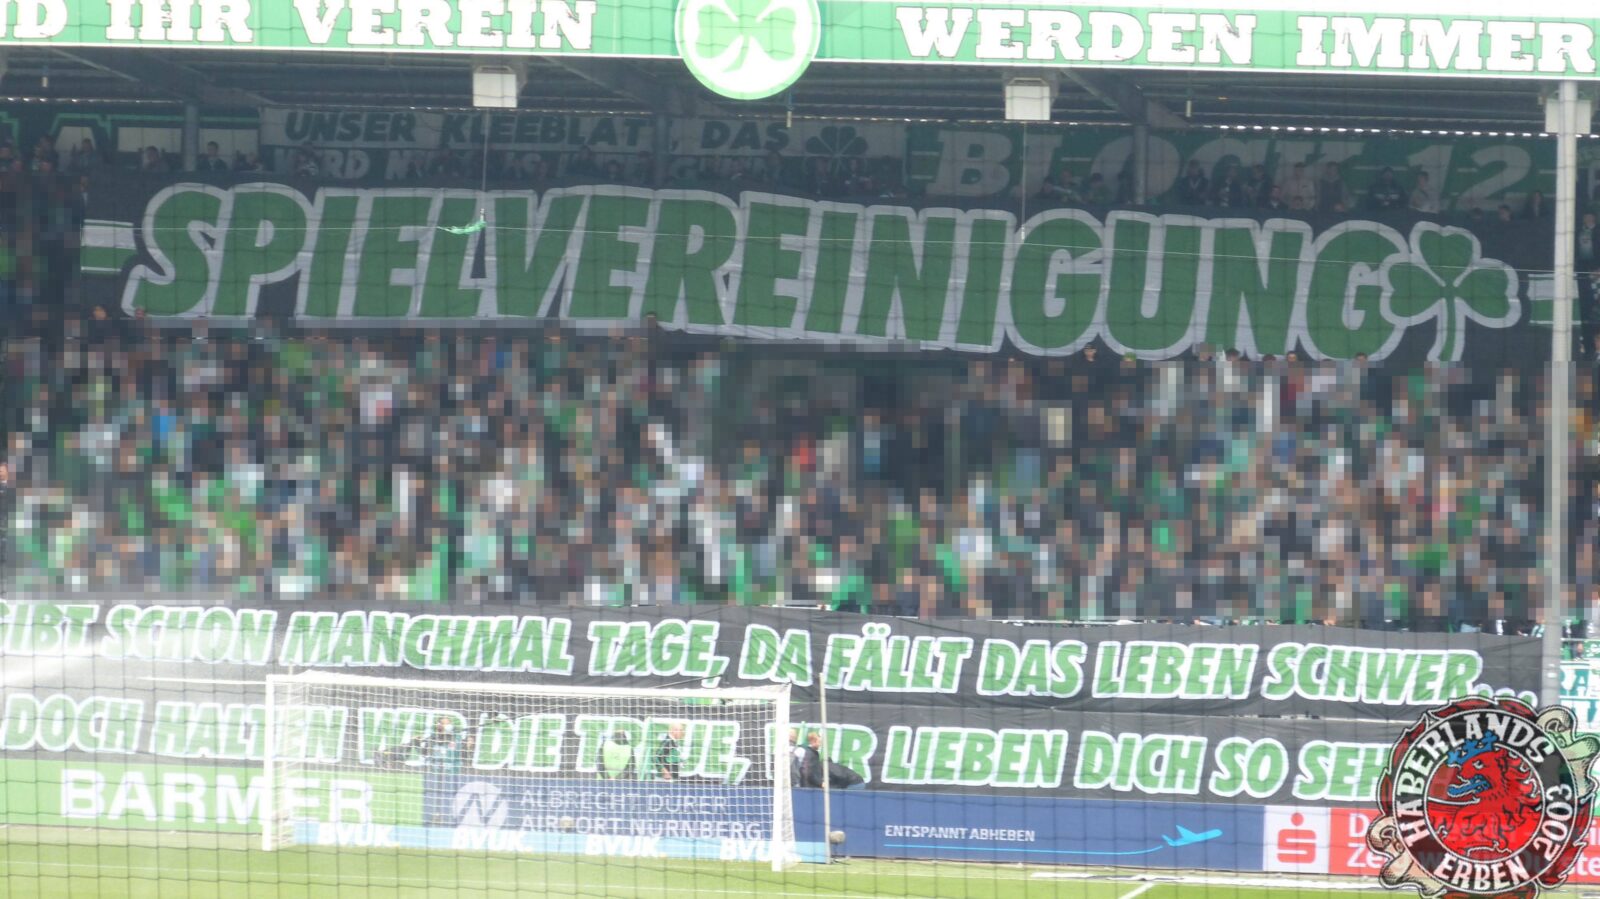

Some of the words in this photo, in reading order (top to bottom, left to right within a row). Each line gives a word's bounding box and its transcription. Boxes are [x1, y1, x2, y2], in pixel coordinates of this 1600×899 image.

[0, 0, 68, 39] D
[105, 0, 253, 43] IHR
[293, 0, 597, 50] VEREIN
[896, 8, 1257, 66] WERDEN
[1296, 16, 1597, 73] IMMER
[285, 111, 417, 143] UNSER
[701, 120, 790, 152] DAS
[926, 129, 1365, 203] BLOCK
[1407, 144, 1532, 212] 12
[121, 182, 1409, 362] SPIELVEREINIGUNG
[102, 603, 278, 666] SCHON
[279, 610, 576, 676] MANCHMAL
[587, 618, 729, 688] TAGE,
[738, 624, 813, 687] DA
[823, 622, 974, 694] FÄLLT
[976, 639, 1088, 699] DAS
[1092, 641, 1259, 701] LEBEN
[0, 693, 144, 755] DOCH
[472, 713, 567, 773] DIE
[881, 726, 1069, 789] LIEBEN
[1073, 731, 1208, 795] DICH
[1208, 737, 1290, 798] SO
[60, 768, 375, 826] BARMER
[520, 788, 641, 812] ALBRECHT
[884, 824, 968, 840] ENTSPANNT
[969, 828, 1035, 842] ABHEBEN
